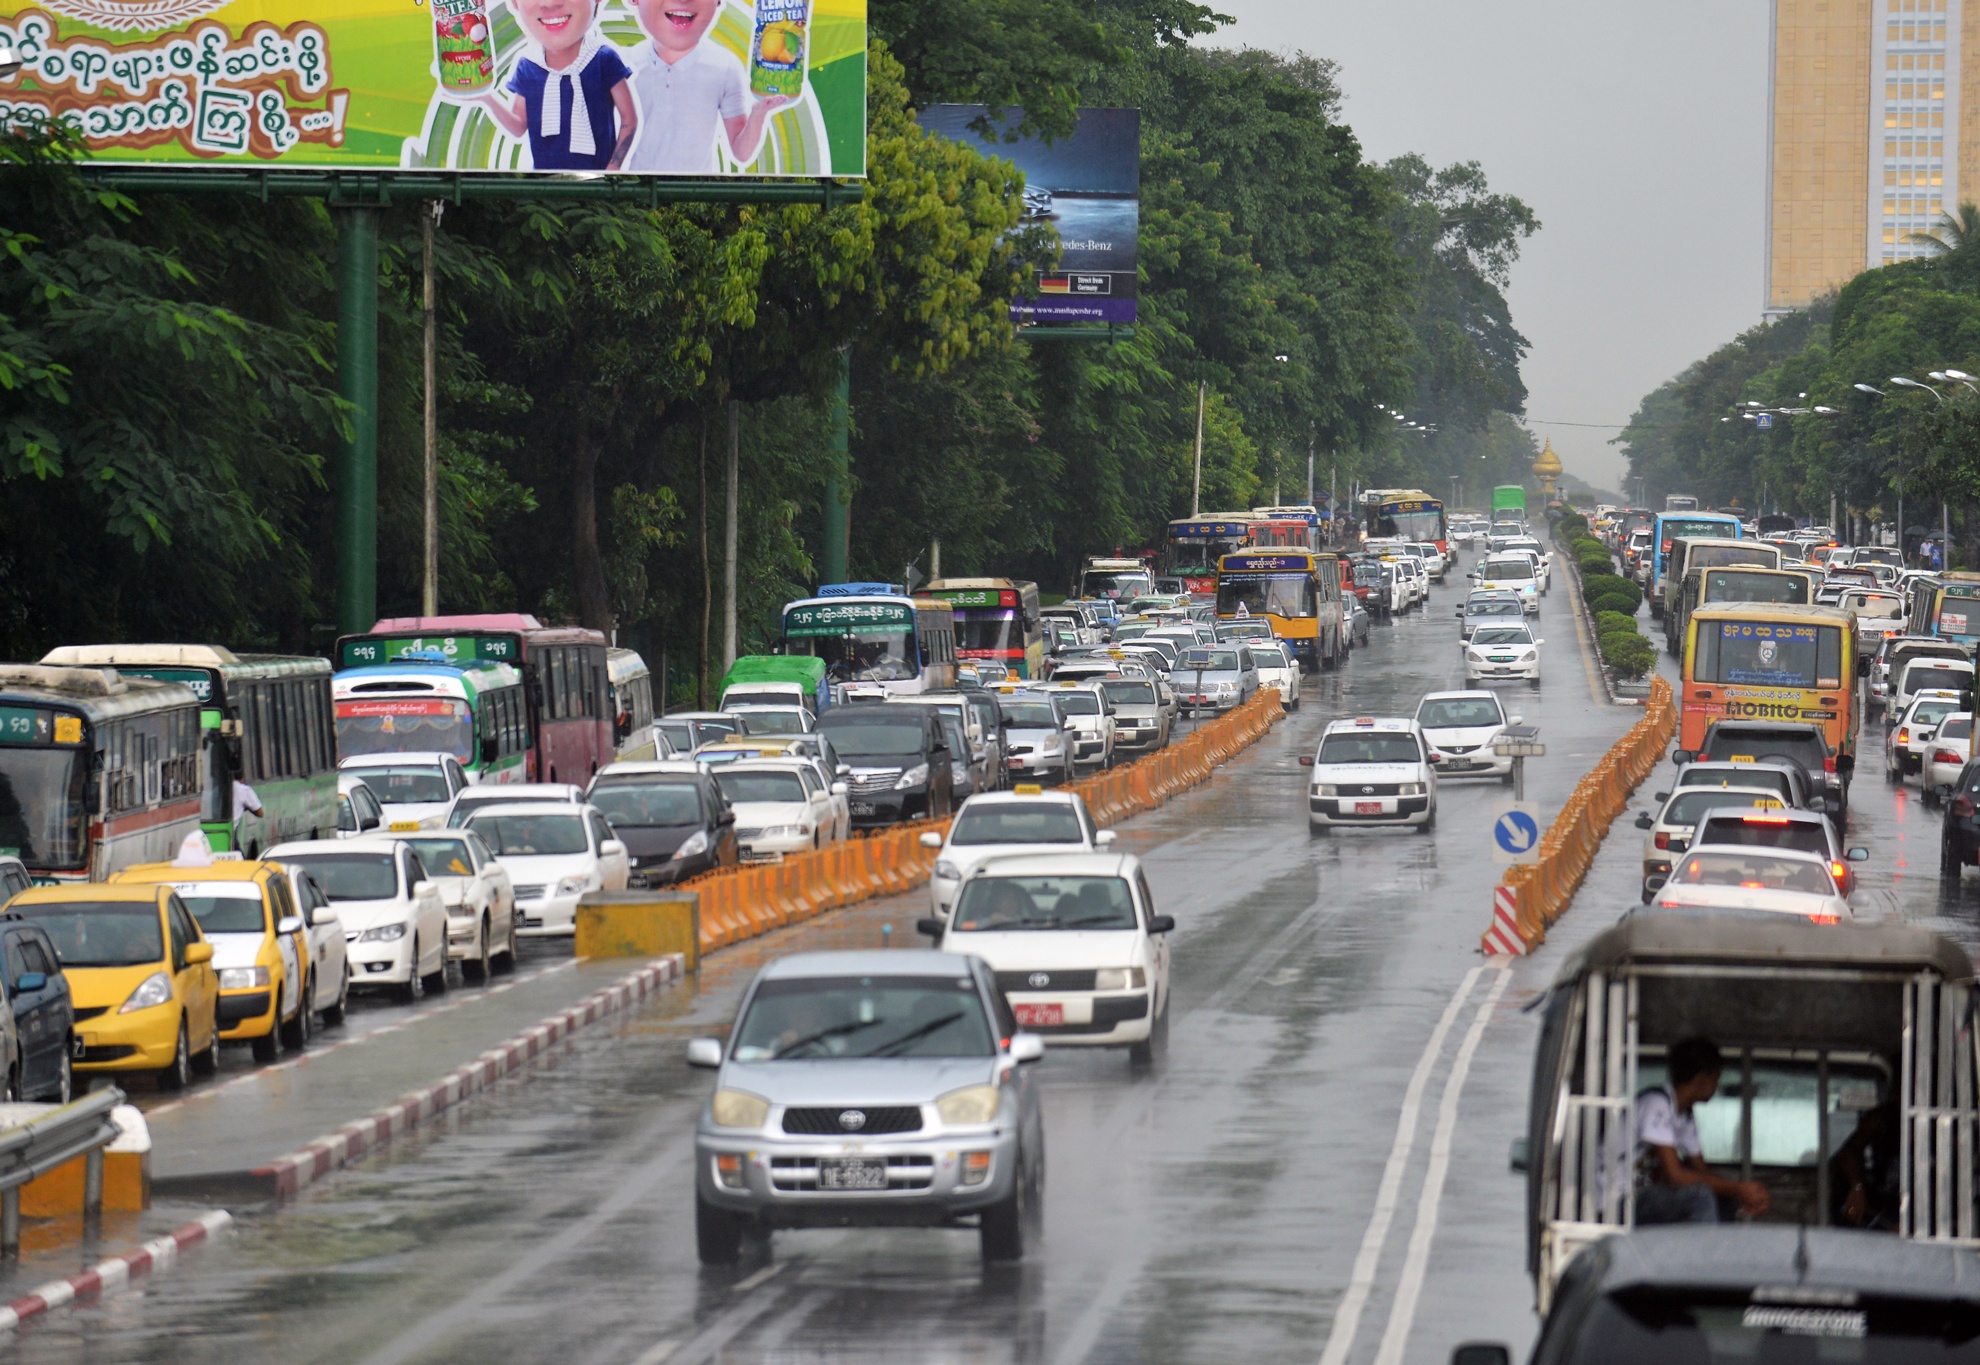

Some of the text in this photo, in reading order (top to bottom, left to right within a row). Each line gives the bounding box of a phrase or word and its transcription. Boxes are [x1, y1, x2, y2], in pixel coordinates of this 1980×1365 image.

[447, 2, 477, 16] TEA
[764, 10, 803, 21] ICED TEA
[1741, 626, 1752, 636] မ
[1755, 626, 1772, 637] ထ
[1775, 627, 1793, 638] သ
